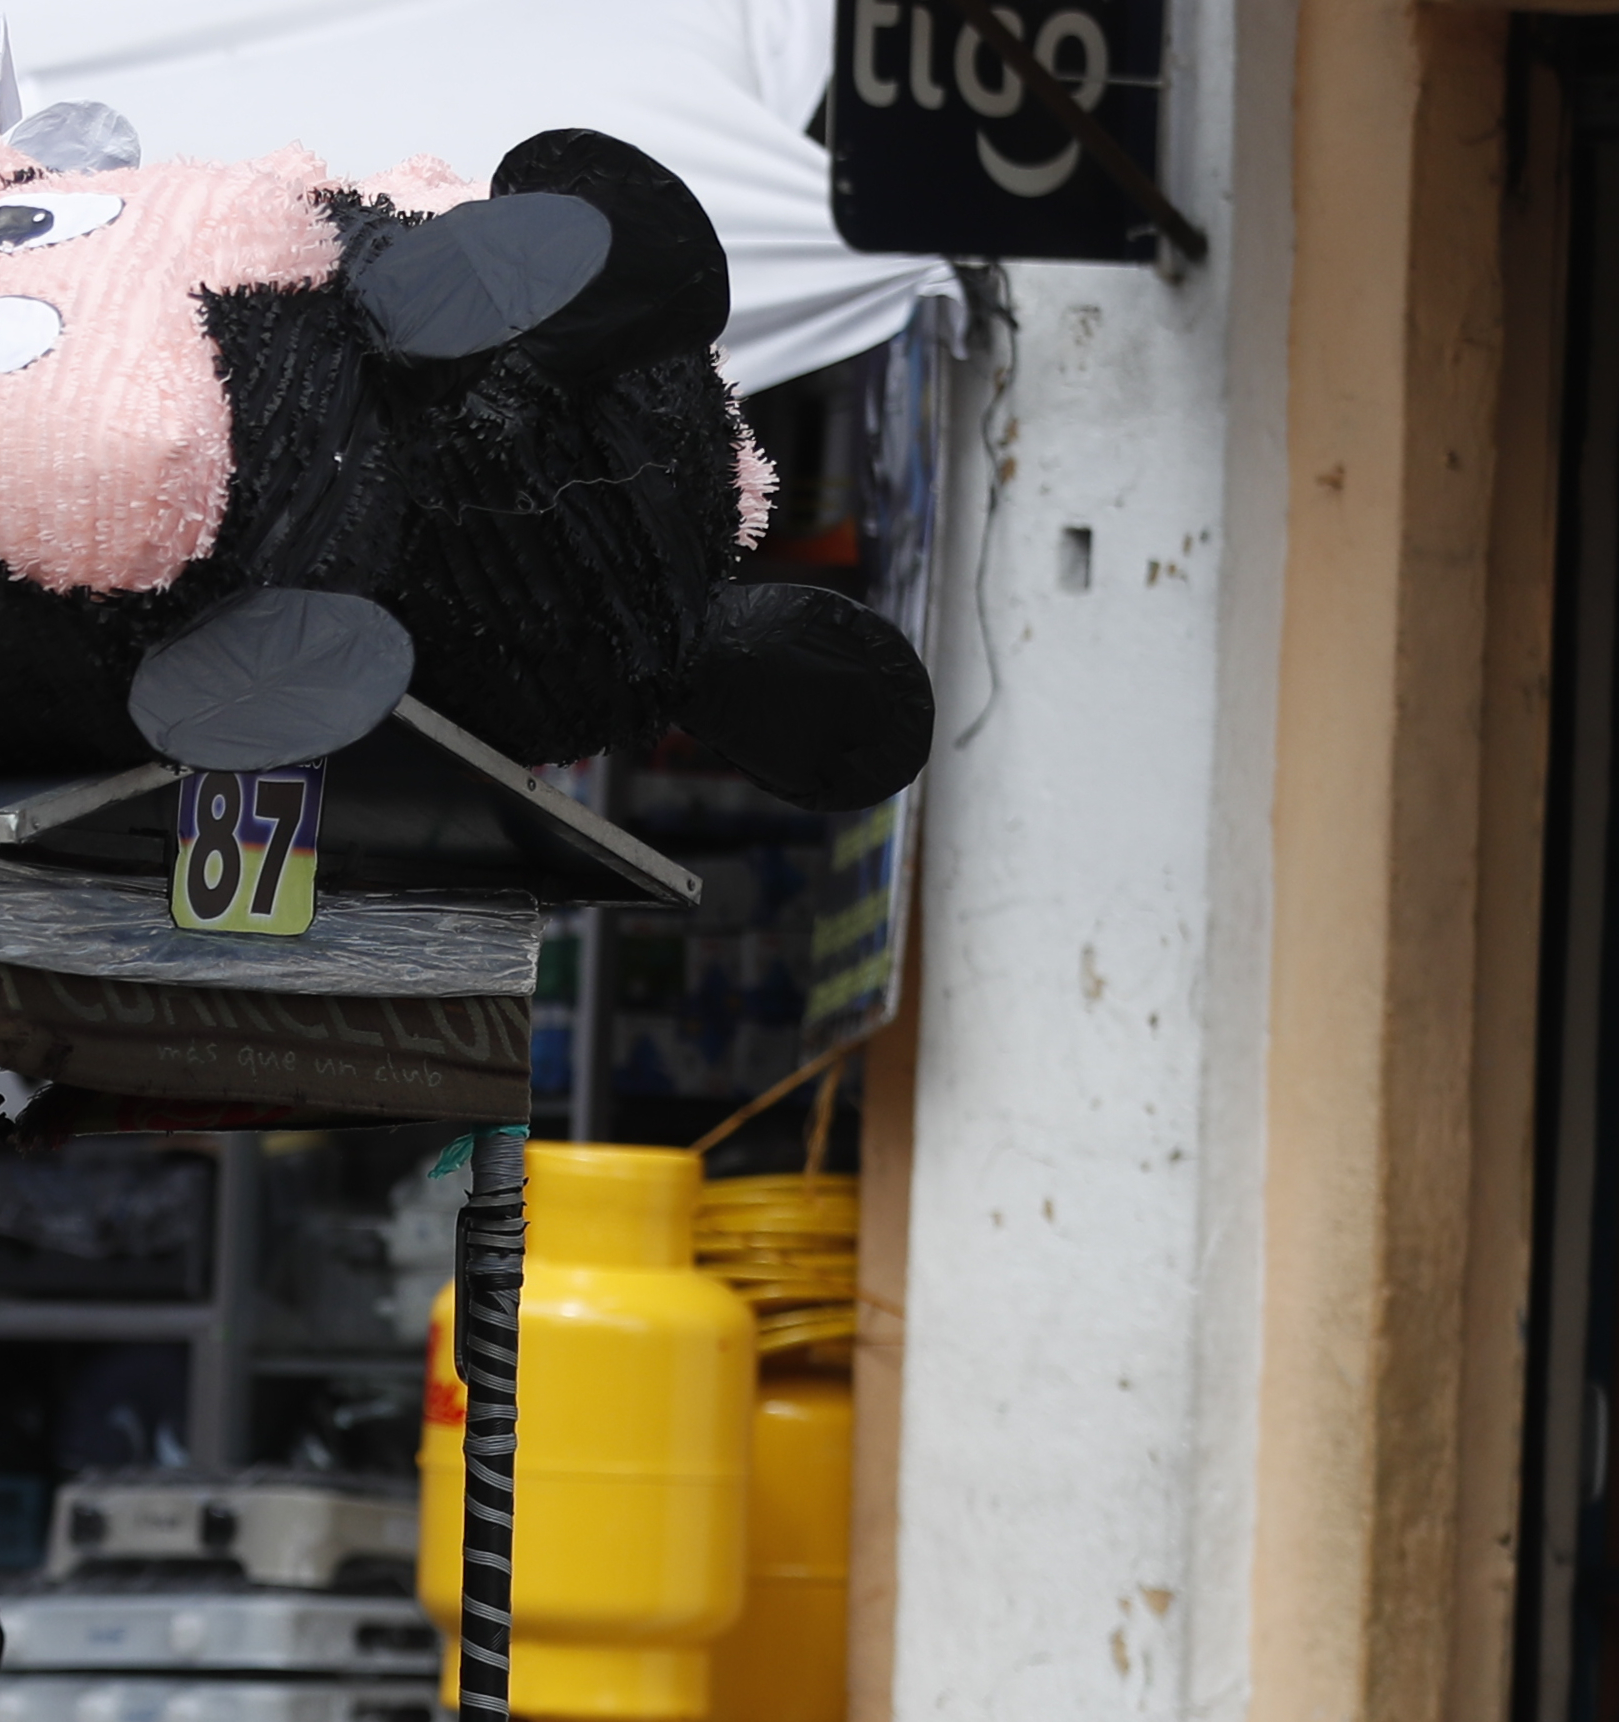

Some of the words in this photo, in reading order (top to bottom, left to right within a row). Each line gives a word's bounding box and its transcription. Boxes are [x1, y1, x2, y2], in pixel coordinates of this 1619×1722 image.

[185, 771, 308, 922] 87
[238, 1044, 297, 1083] que
[315, 1058, 358, 1079] un
[374, 1052, 444, 1088] club
